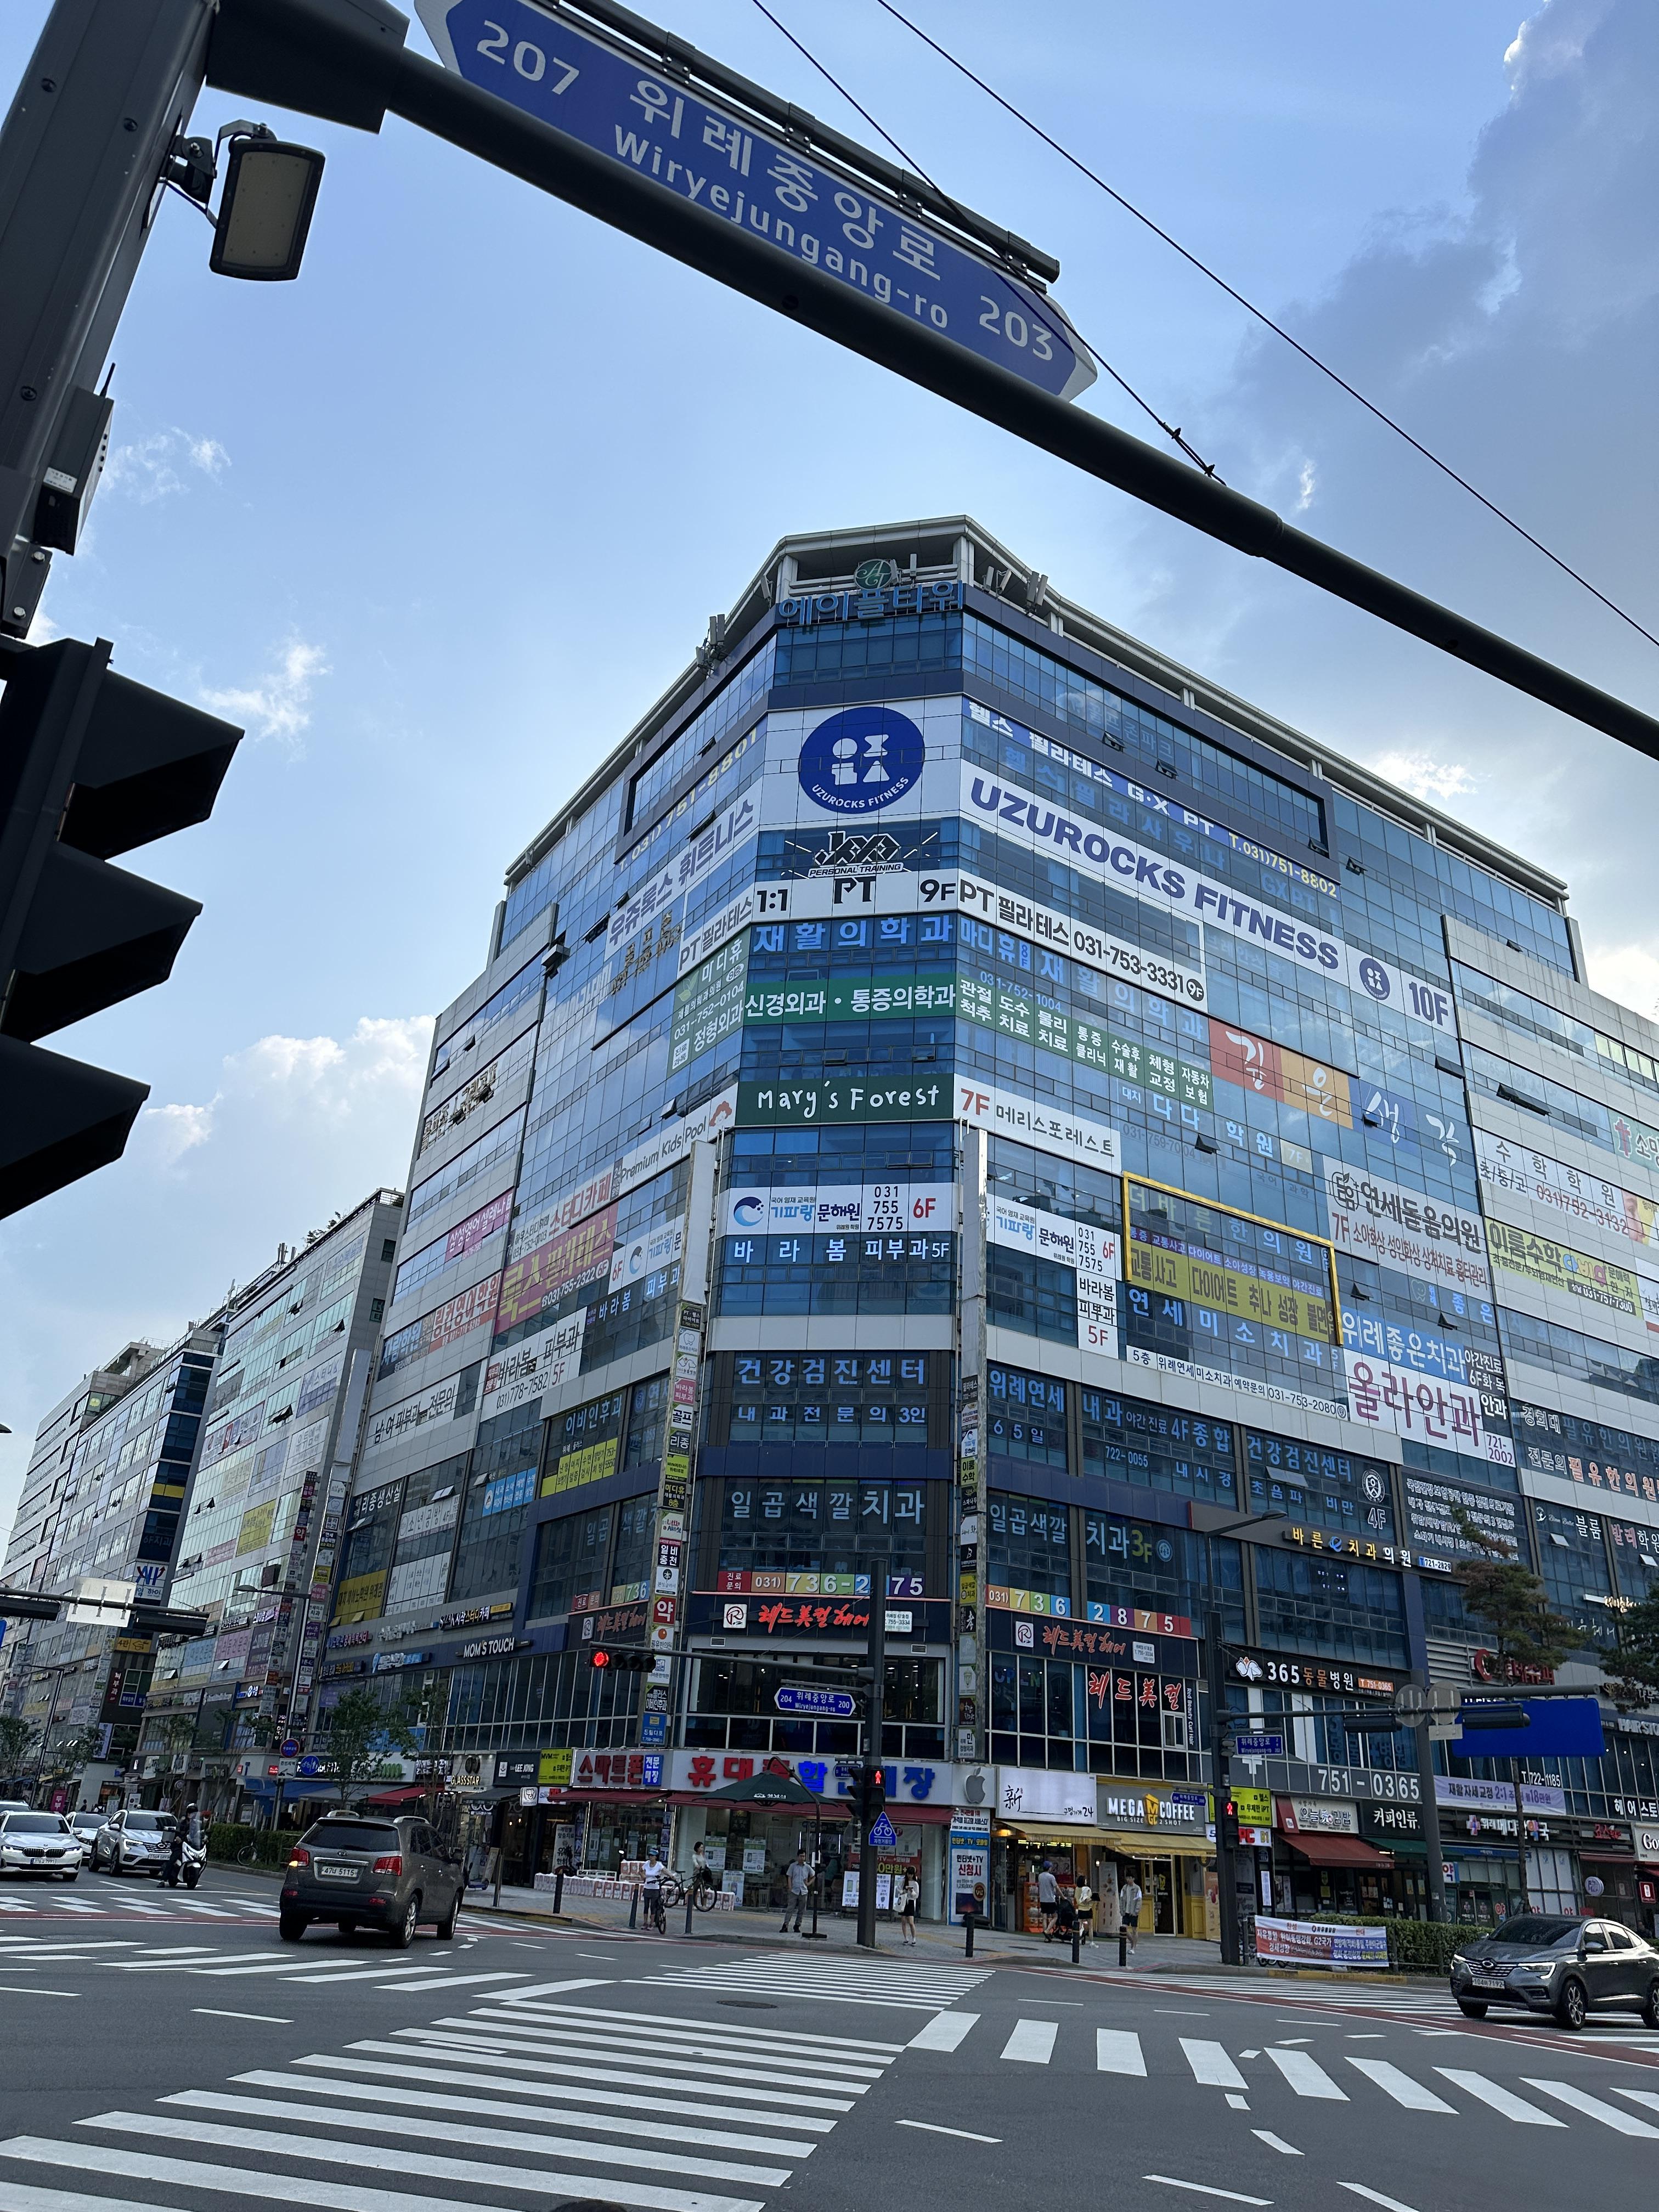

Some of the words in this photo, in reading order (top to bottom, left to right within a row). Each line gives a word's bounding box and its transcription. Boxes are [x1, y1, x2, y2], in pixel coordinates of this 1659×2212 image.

[477, 19, 581, 95] 207
[629, 78, 941, 282] 위례중앙로
[614, 123, 948, 329] Wiryejungang-ro
[979, 295, 1054, 360] 203
[779, 580, 963, 625] 에이플타워
[969, 701, 1013, 737] 헬스
[1030, 732, 1112, 787] 필라테스
[1183, 809, 1214, 836] PT
[812, 784, 866, 809] UZUROCKS
[868, 777, 910, 804] FITNESS
[610, 874, 673, 946] 우주록스
[679, 799, 754, 887] 휘트니스
[809, 866, 859, 877] PERSONAL
[860, 863, 902, 873] TRAINING
[757, 889, 788, 912] 1:1
[833, 877, 877, 904] PT
[920, 879, 956, 902] 9F
[970, 778, 1186, 898] UZUROCKS
[1195, 884, 1338, 969] FITNESS
[1409, 982, 1448, 1026] 10F
[753, 916, 953, 953] 재활의학과
[960, 880, 994, 912] PT
[998, 895, 1069, 946] 필라테스
[1075, 930, 1183, 993] 031-753-3331
[1188, 981, 1203, 997] 9F
[702, 939, 742, 982] 마디휴
[961, 919, 1015, 963] 마디휴
[1041, 949, 1203, 1040] 재활의학과
[746, 991, 825, 1017] 신경외과
[850, 984, 956, 1012] 통증의학과
[695, 1005, 743, 1052] 정형외과
[960, 980, 991, 1005] 관절
[1000, 994, 1029, 1017] 도수
[1038, 1010, 1067, 1034] 물리
[1077, 1026, 1102, 1047] 통증
[1112, 1040, 1140, 1062] 수술후
[1149, 1054, 1175, 1075] 체형
[1182, 1066, 1209, 1088] 자동차
[960, 998, 991, 1022] 척추
[1000, 1016, 1030, 1037] 치료
[1039, 1029, 1068, 1052] 치료
[1076, 1044, 1105, 1066] 클리닉
[1115, 1059, 1138, 1079] 재활
[1149, 1071, 1175, 1092] 교정
[1186, 1082, 1207, 1105] 보험
[758, 1080, 838, 1118] Mary's
[850, 1085, 939, 1110] Forest
[961, 1088, 989, 1115] 7F
[996, 1106, 1114, 1157] 메리스포레스트
[1226, 1121, 1273, 1158] 학원
[620, 1153, 659, 1181] Premium
[661, 1132, 682, 1157] Kids
[549, 1173, 611, 1232] 스터디카페
[874, 1186, 899, 1198] 031
[771, 1205, 814, 1219] 기파랑
[817, 1203, 860, 1222] 문해원
[874, 1200, 899, 1214] 755
[913, 1198, 936, 1218] 6F
[1361, 1181, 1481, 1254] 연세돋움의원
[867, 1216, 903, 1231] 7575
[1079, 1227, 1094, 1240] 031
[1332, 1212, 1349, 1242] 7F
[733, 1239, 847, 1263] 바라봄
[865, 1239, 928, 1260] 피부과
[932, 1242, 950, 1257] 5F
[1039, 1230, 1074, 1253] 문해원
[1079, 1240, 1095, 1256] 755
[1103, 1241, 1114, 1259] 6F
[1079, 1255, 1102, 1272] 7575
[1080, 1277, 1114, 1301] 바라봄
[1192, 1267, 1238, 1306] 다이어트
[1249, 1284, 1272, 1316] 추나
[1278, 1294, 1298, 1325] 성장
[599, 1289, 631, 1321] 바라봄
[1079, 1300, 1115, 1325] 피부과
[1088, 1325, 1109, 1346] 5F
[1342, 1311, 1465, 1379] 위례좋은치과
[1464, 1350, 1502, 1373] 야간진료
[552, 1361, 565, 1385] 5F
[738, 1359, 925, 1385] 건강검진센터
[1133, 1349, 1150, 1365] 5층
[1234, 1379, 1265, 1396] 예약문의
[1268, 1386, 1336, 1415] 031-753-2080
[496, 1370, 548, 1408] 031)778-7582
[676, 1383, 693, 1393] 바라봄
[566, 1393, 622, 1436] 이비인후과
[899, 1407, 926, 1423] 3인
[1349, 1362, 1480, 1447] 올라안과
[1481, 1393, 1507, 1420] 안과
[673, 1409, 692, 1426] 골프
[989, 1370, 1064, 1413] 위례연세
[1083, 1393, 1122, 1426] 내과
[1247, 1434, 1351, 1482] 건강검진센터
[670, 1436, 690, 1449] 리종
[1105, 1445, 1148, 1468] 722-0055
[1489, 1448, 1514, 1465] 2002
[962, 1471, 974, 1482] 수학
[665, 1485, 685, 1494] 마디휴
[668, 1499, 679, 1508] 8층
[990, 1504, 1067, 1545] 일곱색깔
[1368, 1508, 1386, 1530] 4F
[726, 1581, 741, 1590] 문의
[727, 1572, 741, 1581] 진료
[755, 1577, 781, 1589] 031)
[989, 1590, 1008, 1604] 031)
[656, 1601, 674, 1621] 약
[463, 1640, 487, 1658] MOM'S
[487, 1637, 515, 1654] TOUCH
[1268, 1661, 1300, 1684] 365
[781, 1695, 792, 1703] 204
[797, 1691, 835, 1703] 위례중앙로
[838, 1701, 850, 1709] 200
[1241, 1737, 1270, 1747] 위례중앙로
[578, 1754, 644, 1785] 스마트폰
[645, 1757, 659, 1769] 전문
[645, 1770, 659, 1784] 매장
[1082, 1807, 1093, 1818] 24
[1107, 1797, 1144, 1817] MEGA
[1160, 1801, 1194, 1821] COFFEE
[1333, 1811, 1351, 1825] 김밥
[1239, 1827, 1255, 1843] PC
[958, 1864, 981, 1877] 신청시
